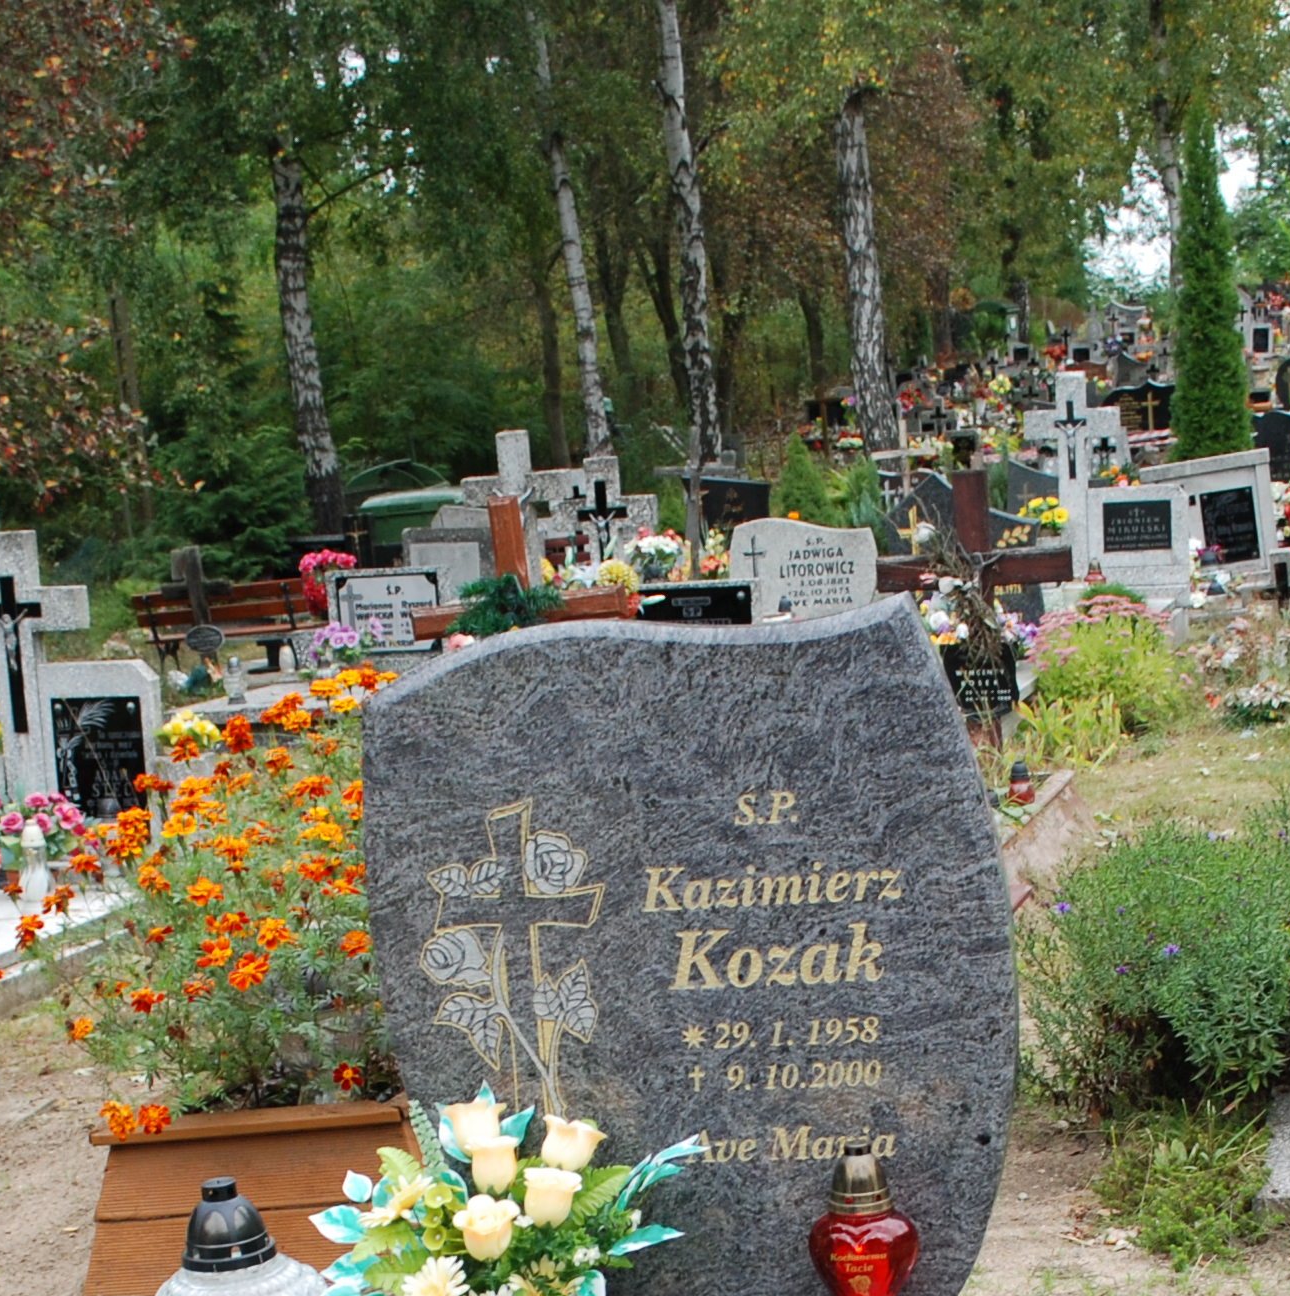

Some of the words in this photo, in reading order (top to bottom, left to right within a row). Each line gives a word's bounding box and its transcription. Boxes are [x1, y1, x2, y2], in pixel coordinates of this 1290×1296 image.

[779, 560, 856, 579] LITOROWICZ
[788, 546, 844, 561] JADWIGA
[734, 785, 799, 827] Ś.P.
[642, 861, 904, 913] Kazimierz
[668, 920, 886, 990] Kozak
[807, 1016, 881, 1046] 1958
[686, 1129, 758, 1164] Ave
[844, 1262, 874, 1273] Tacie
